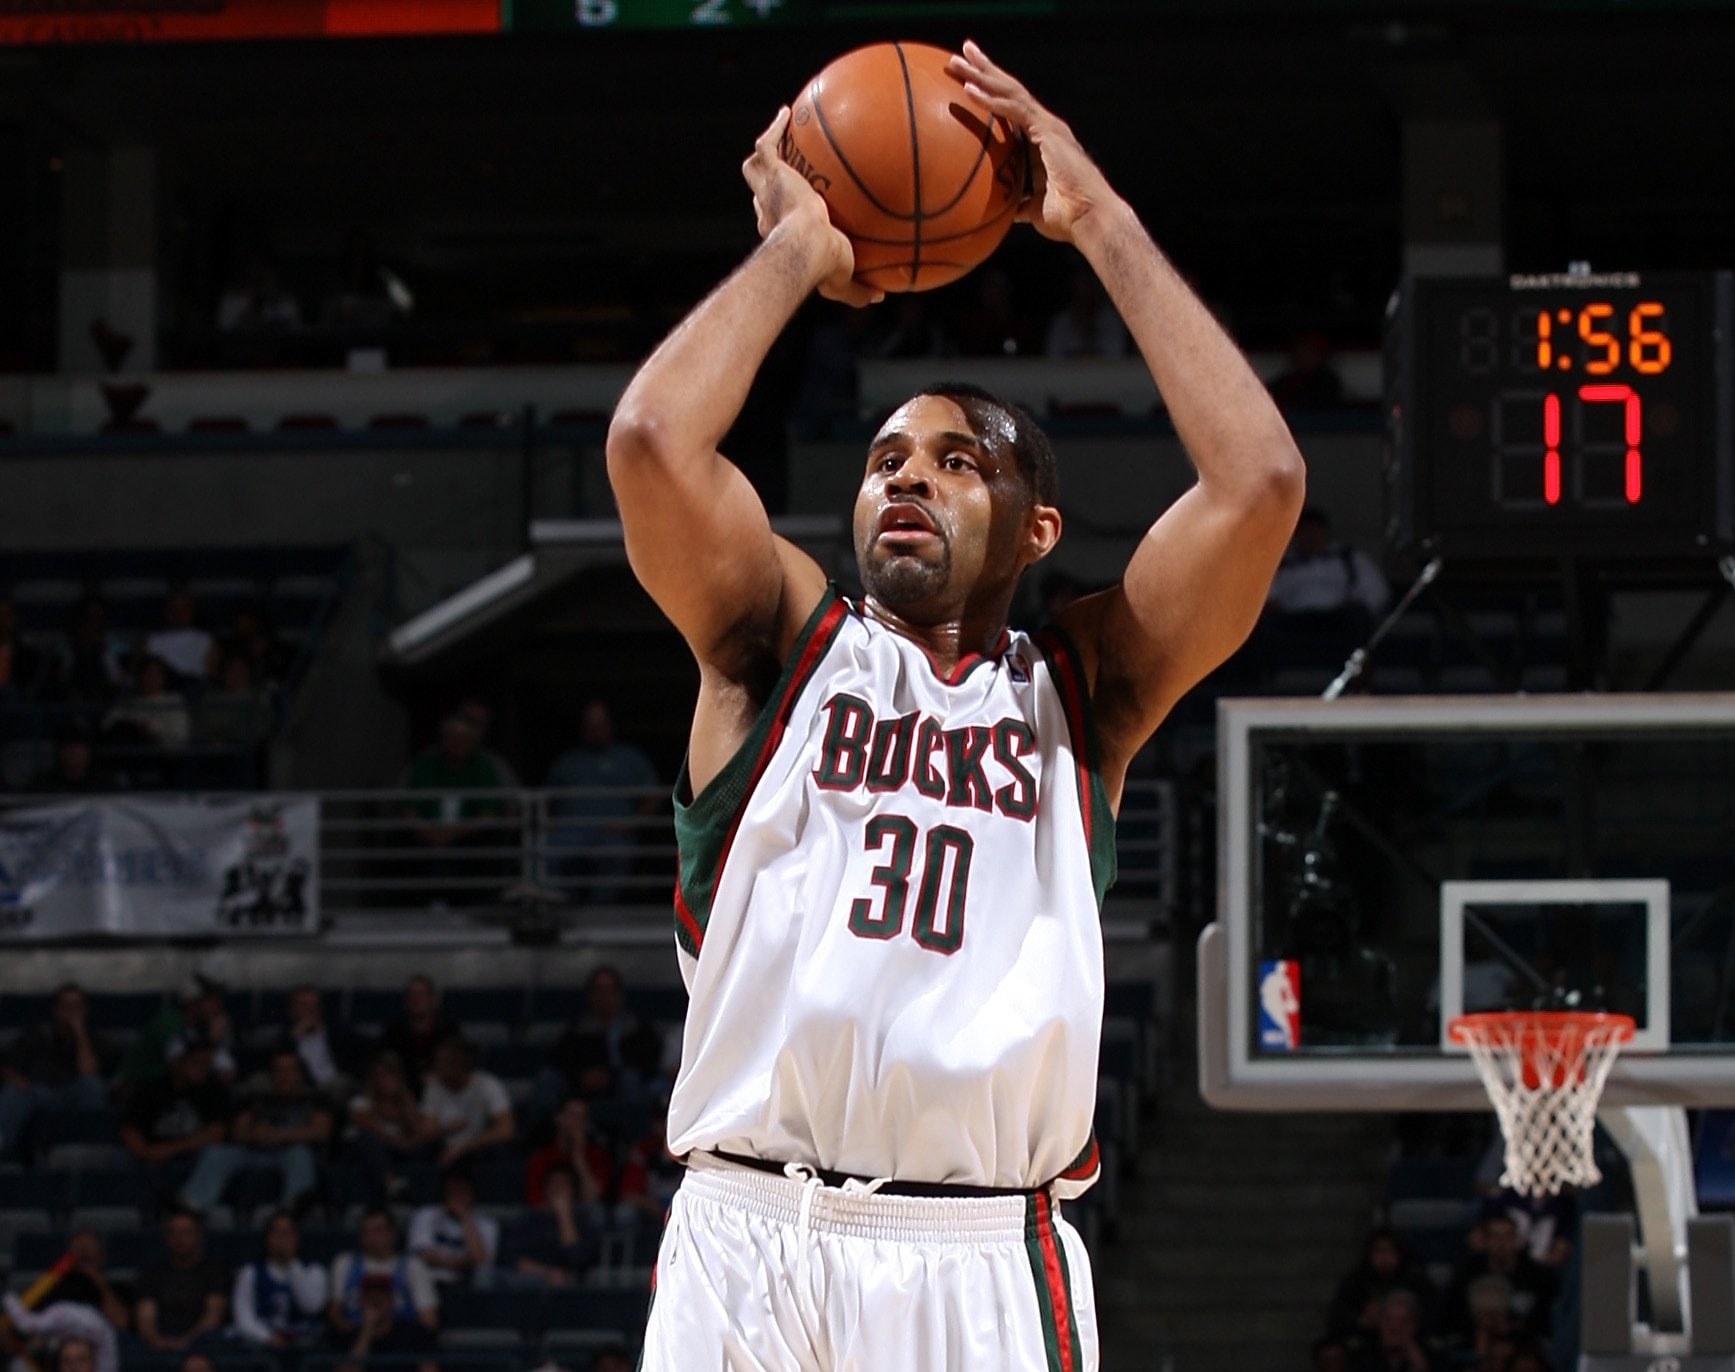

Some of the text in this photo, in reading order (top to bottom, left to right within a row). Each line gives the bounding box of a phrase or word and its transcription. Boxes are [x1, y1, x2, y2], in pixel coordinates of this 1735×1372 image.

[1536, 302, 1671, 375] 1:56
[1543, 383, 1642, 506] 17
[811, 692, 1039, 823] BUCKS
[848, 814, 974, 956] 30
